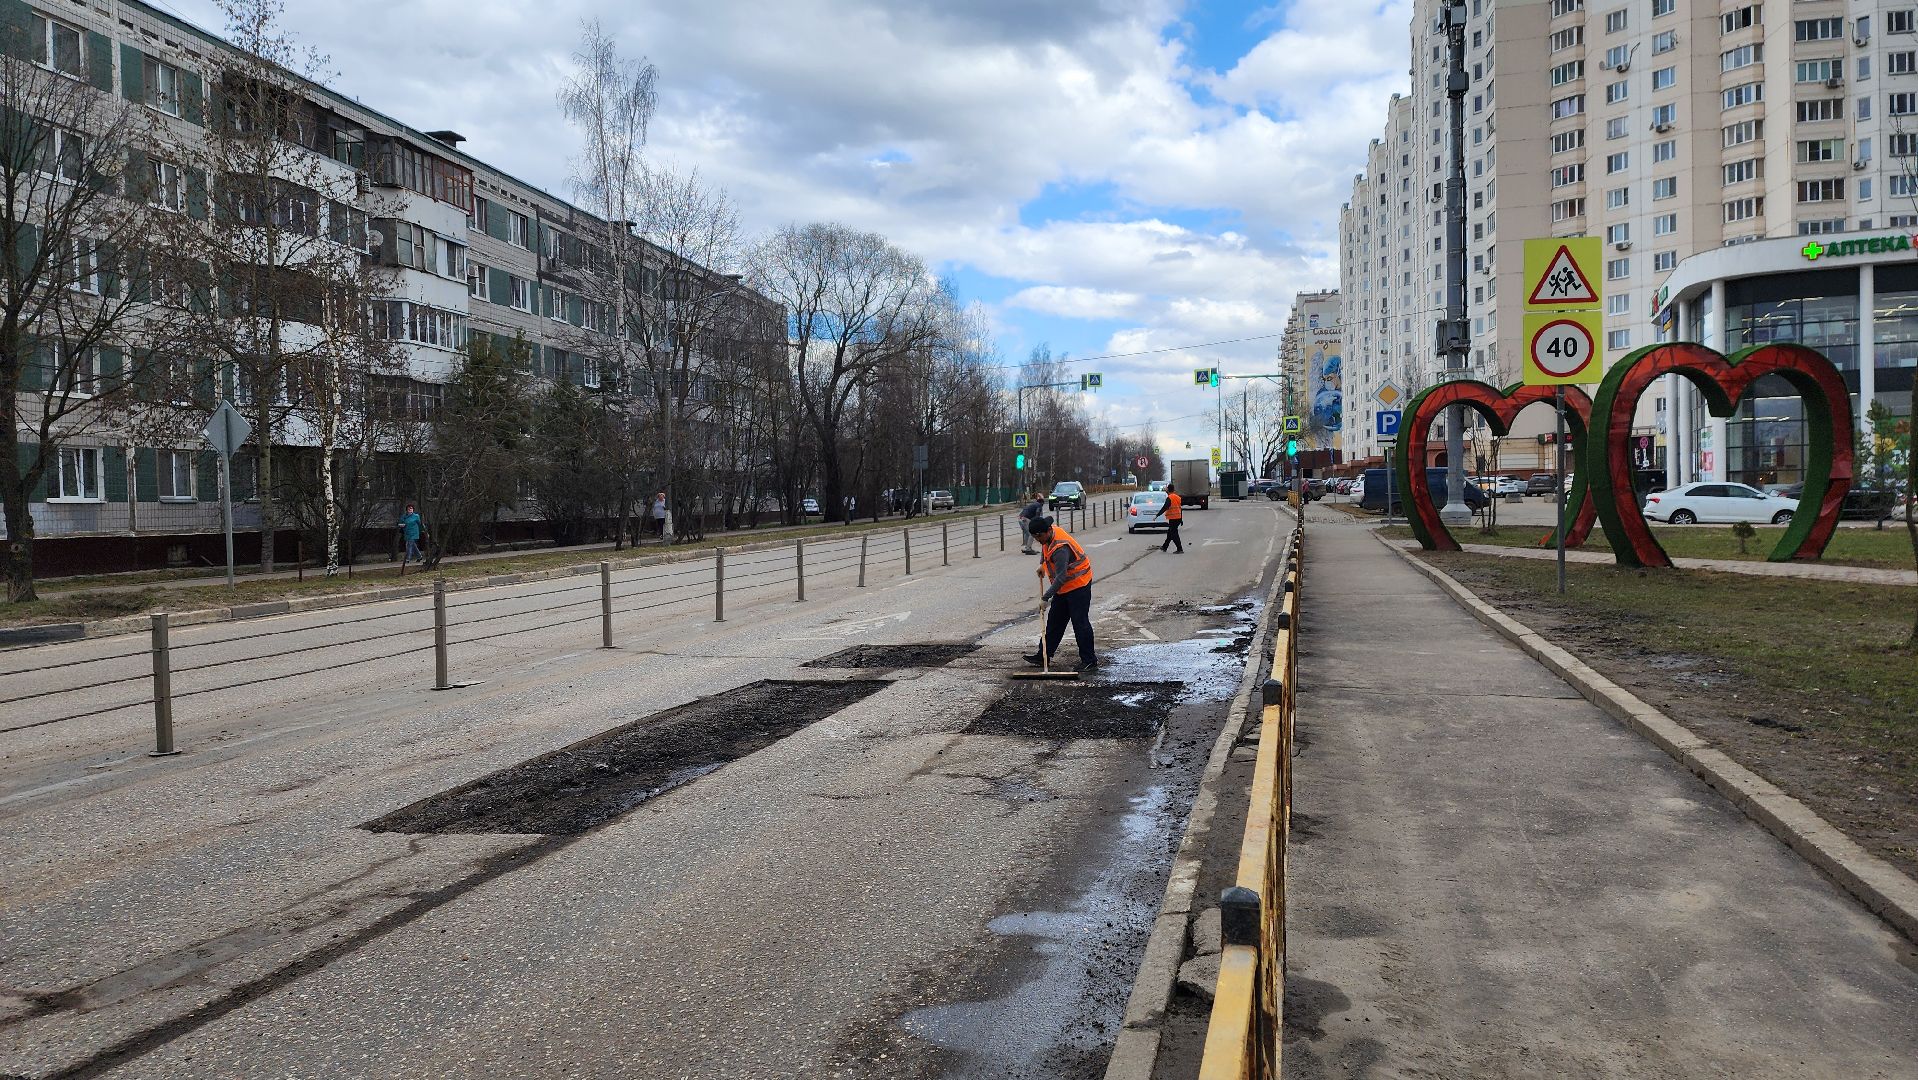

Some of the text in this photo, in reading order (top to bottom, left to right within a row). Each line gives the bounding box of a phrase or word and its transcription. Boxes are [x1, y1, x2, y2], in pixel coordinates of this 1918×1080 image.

[1826, 235, 1910, 257] АПТЕКА
[1547, 337, 1577, 357] 40
[1383, 414, 1396, 432] P
